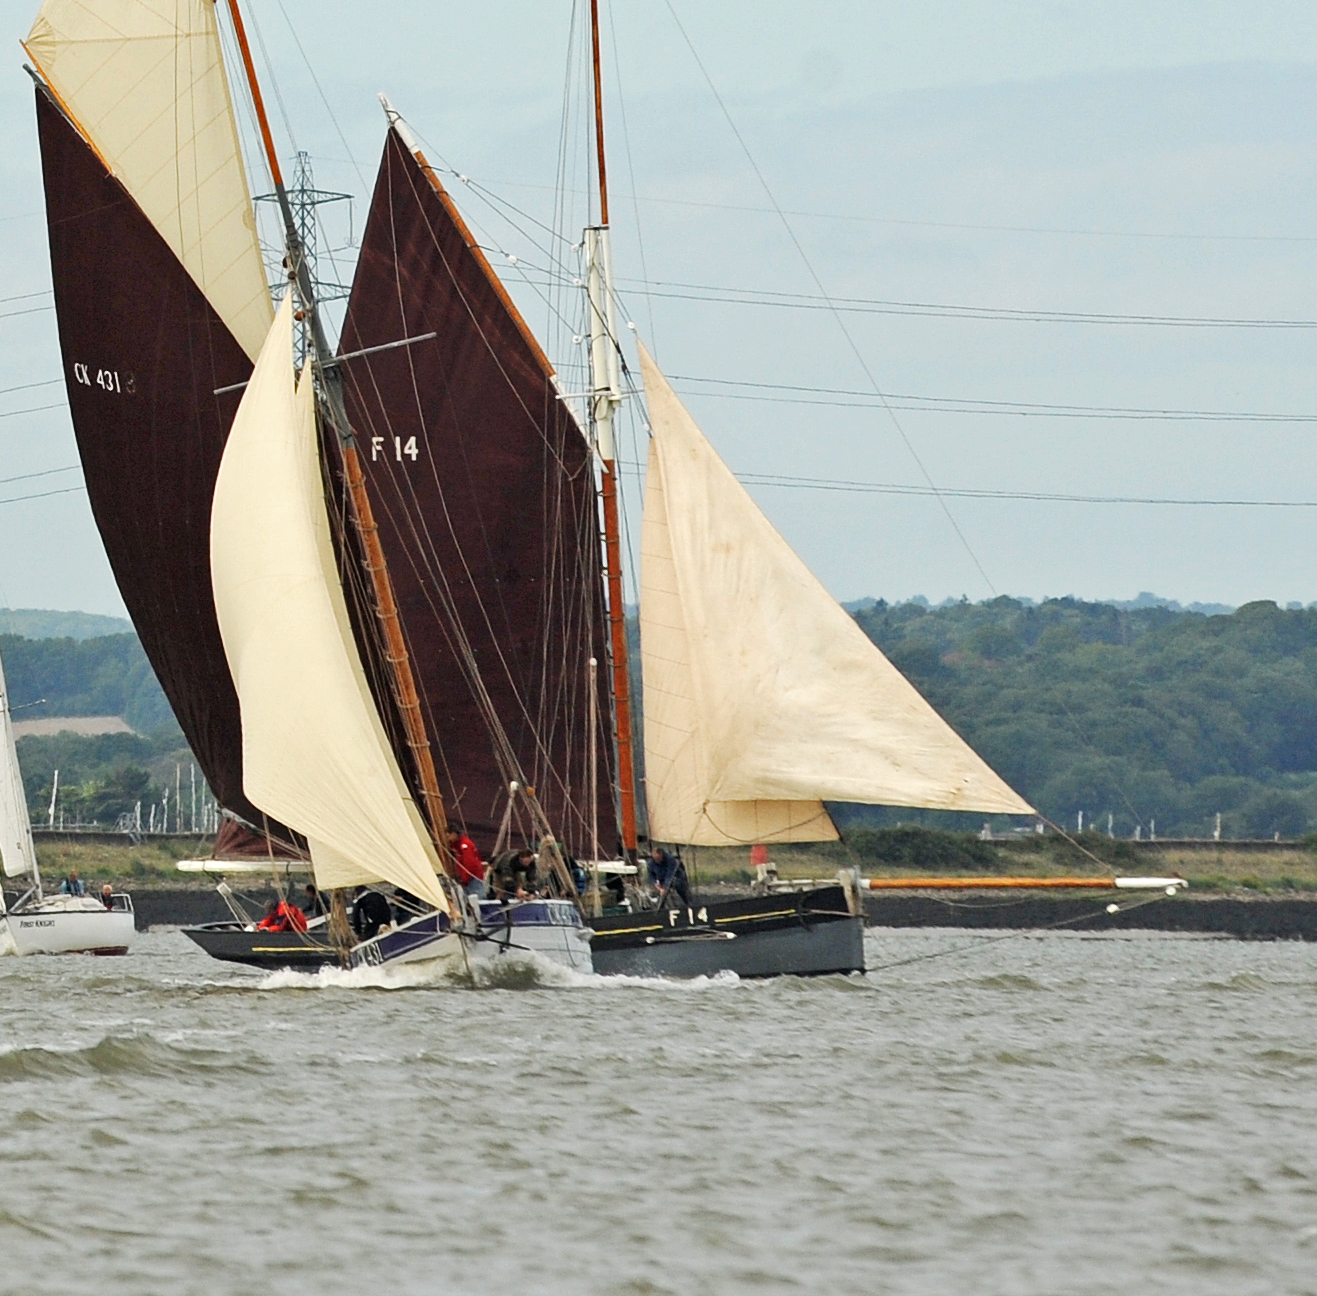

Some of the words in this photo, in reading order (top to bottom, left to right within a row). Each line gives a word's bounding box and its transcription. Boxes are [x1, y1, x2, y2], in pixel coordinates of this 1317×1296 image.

[73, 362, 91, 387] CK
[96, 369, 121, 394] 431
[371, 436, 384, 461] F
[394, 435, 419, 461] 14
[669, 909, 681, 927] F
[687, 906, 708, 925] 14
